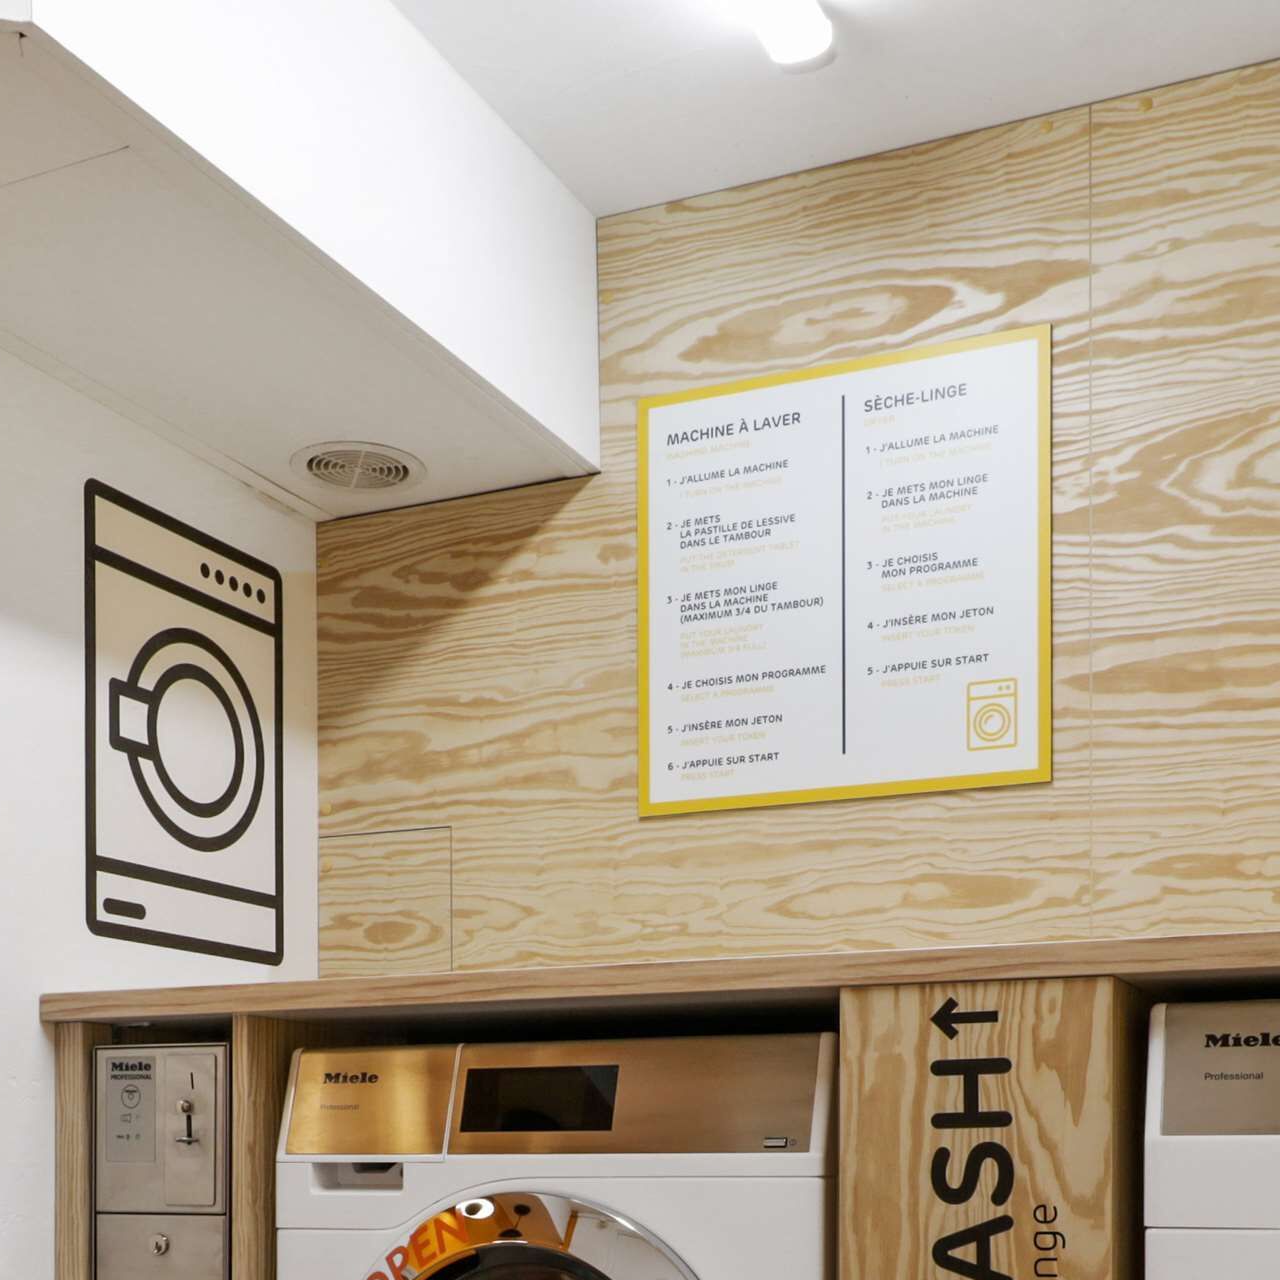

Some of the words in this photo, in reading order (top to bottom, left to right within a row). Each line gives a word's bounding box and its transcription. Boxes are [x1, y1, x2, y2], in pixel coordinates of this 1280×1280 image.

[864, 383, 967, 412] SÈCHE-LINGE
[666, 423, 734, 446] MACHINE
[738, 417, 749, 434] À
[753, 411, 801, 431] LAVER
[865, 445, 870, 455] 1
[879, 436, 929, 452] J'ALLUME
[932, 433, 945, 444] LA
[949, 424, 999, 441] MACHINE
[666, 478, 671, 487] 1
[679, 469, 725, 485] J'ALLUME
[728, 467, 740, 477] LA
[743, 459, 789, 475] MACHINE
[866, 490, 873, 500] 2
[882, 487, 893, 498] JE
[897, 482, 926, 495] METS
[928, 478, 954, 491] MON
[957, 473, 988, 486] LINGE
[881, 496, 910, 509] DANS
[913, 494, 926, 504] LA
[928, 486, 978, 502] MACHINE
[666, 522, 672, 530] 2
[680, 519, 691, 528] JE
[694, 514, 721, 526] METS
[679, 529, 691, 539] LA
[694, 522, 737, 537] PASTILLE
[740, 520, 753, 530] DE
[756, 513, 796, 528] LESSIVE
[679, 537, 706, 549] DANS
[709, 535, 720, 545] LE
[723, 527, 771, 543] TAMBOUR
[867, 561, 872, 570] 3
[882, 558, 893, 568] JE
[897, 552, 938, 566] CHOISIS
[881, 567, 906, 579] MON
[909, 557, 978, 575] PROGRAMME
[666, 595, 672, 604] 3
[680, 593, 691, 602] JE
[694, 589, 721, 600] METS
[723, 585, 747, 596] MON
[749, 581, 778, 593] LINGE
[679, 601, 706, 613] DANS
[709, 599, 721, 609] LA
[723, 593, 768, 607] MACHINE
[680, 608, 732, 624] (MAXIMUM
[735, 606, 751, 616] 3/4
[754, 604, 768, 614] DU
[771, 596, 824, 613] TAMBOUR)
[867, 621, 873, 630] 4
[882, 614, 927, 628] J'INSÈRE
[931, 610, 956, 622] MON
[959, 606, 994, 619] JETON
[867, 666, 873, 676] 5
[882, 660, 927, 674] J'APPUIE
[931, 657, 952, 668] SUR
[955, 653, 989, 666] START
[667, 682, 673, 691] 4
[681, 680, 692, 690] JE
[695, 675, 733, 688] CHOISIS
[735, 672, 759, 683] MON
[761, 664, 826, 680] PROGRAMME
[667, 725, 673, 734] 5
[680, 719, 722, 733] J'INSÈRE
[725, 717, 748, 728] MON
[750, 714, 783, 725] JETON
[667, 762, 673, 771] 6
[681, 757, 723, 769] J'APPUIE
[726, 755, 746, 765] SUR
[748, 751, 780, 763] START
[111, 1061, 152, 1072] Miele
[1204, 1072, 1264, 1081] Professional
[323, 1072, 379, 1085] Miele
